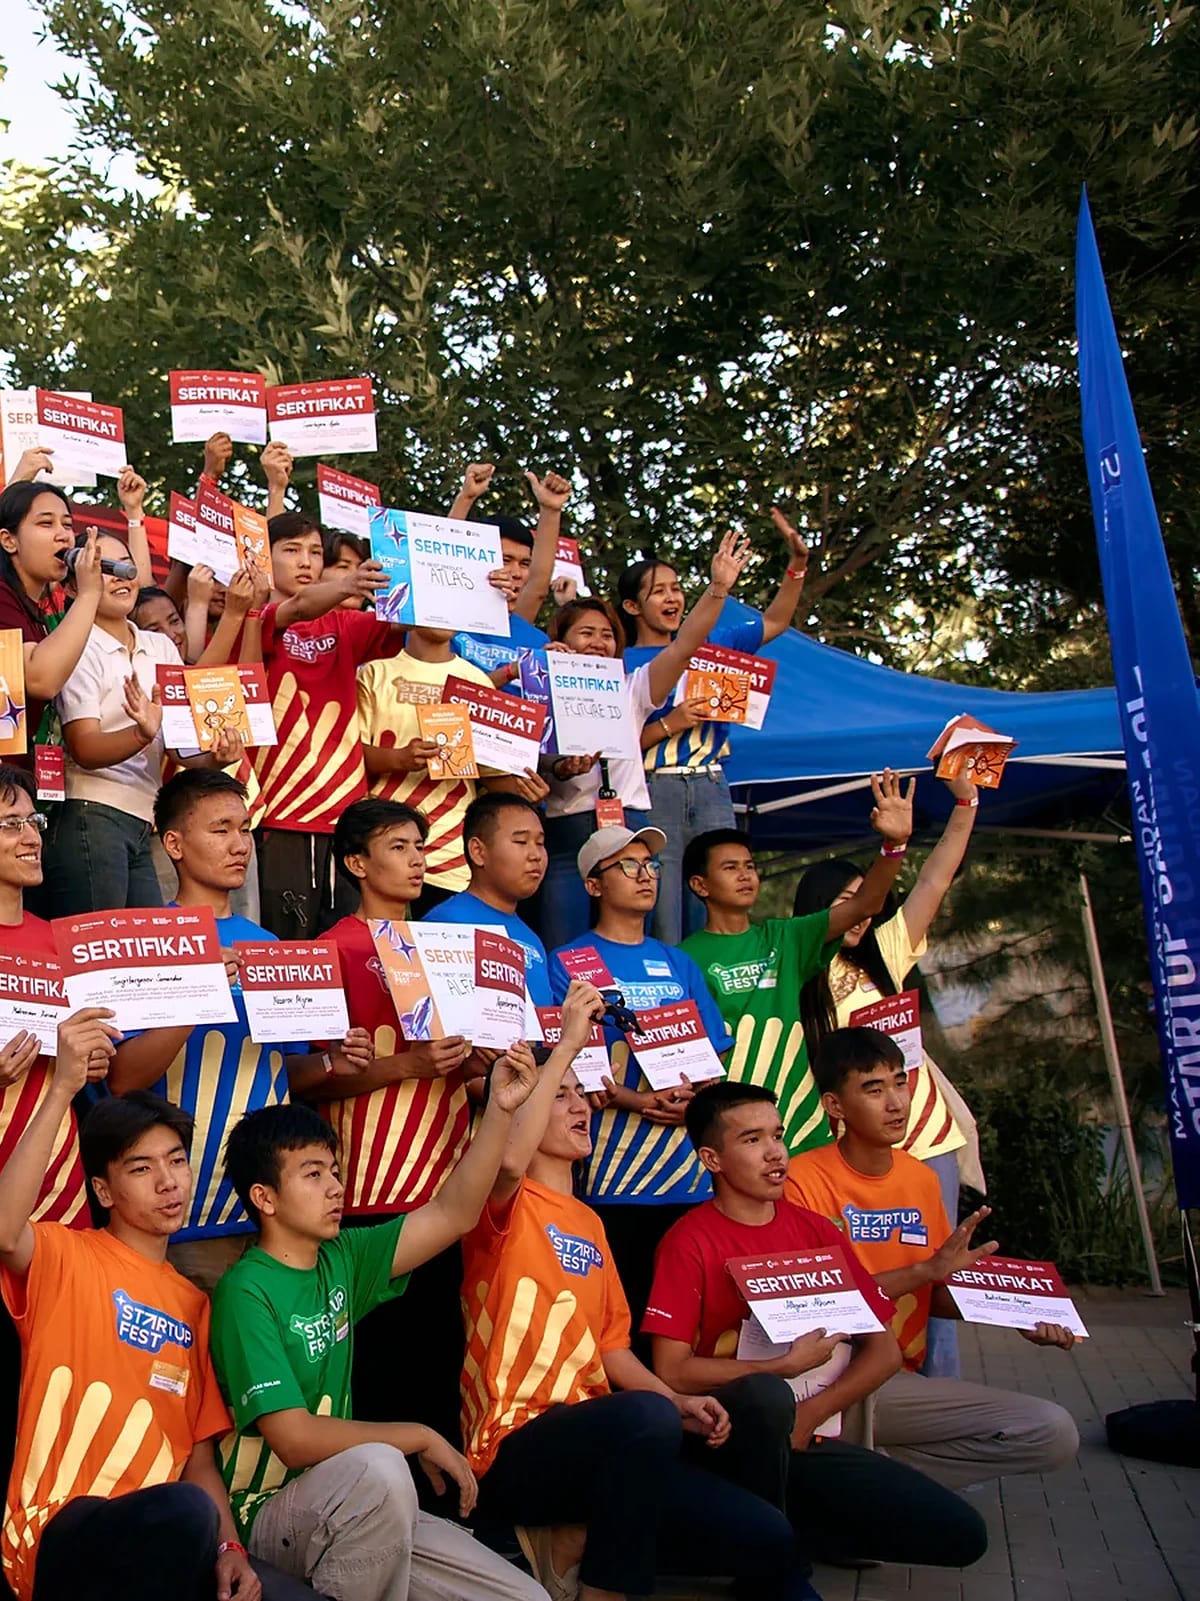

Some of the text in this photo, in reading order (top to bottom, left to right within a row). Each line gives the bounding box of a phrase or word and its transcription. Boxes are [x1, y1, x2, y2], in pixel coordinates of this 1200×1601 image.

[177, 387, 259, 403] SERTIFIKAT
[276, 396, 366, 416] SERTIFIKAT
[43, 408, 118, 437] SERTIFIKAT
[414, 538, 496, 564] SERTIFIKAT
[431, 567, 474, 590] ATLAS
[465, 641, 517, 661] STARTU
[555, 675, 620, 693] SERTIFIKAT
[72, 935, 207, 964] SERTIFIKAT
[424, 949, 474, 965] SERTIF
[246, 964, 333, 982] SERTIFIKAT
[724, 975, 759, 991] FEST
[622, 985, 680, 997] STARTUP
[625, 996, 657, 1008] FEST
[852, 1212, 920, 1225] STARTUP
[852, 1226, 890, 1239] FEST
[746, 1269, 844, 1294] SERTIFIKAT
[952, 1270, 1054, 1292] SERTIFIKAT
[120, 1320, 162, 1348] FEST
[121, 1304, 192, 1344] STARTUP
